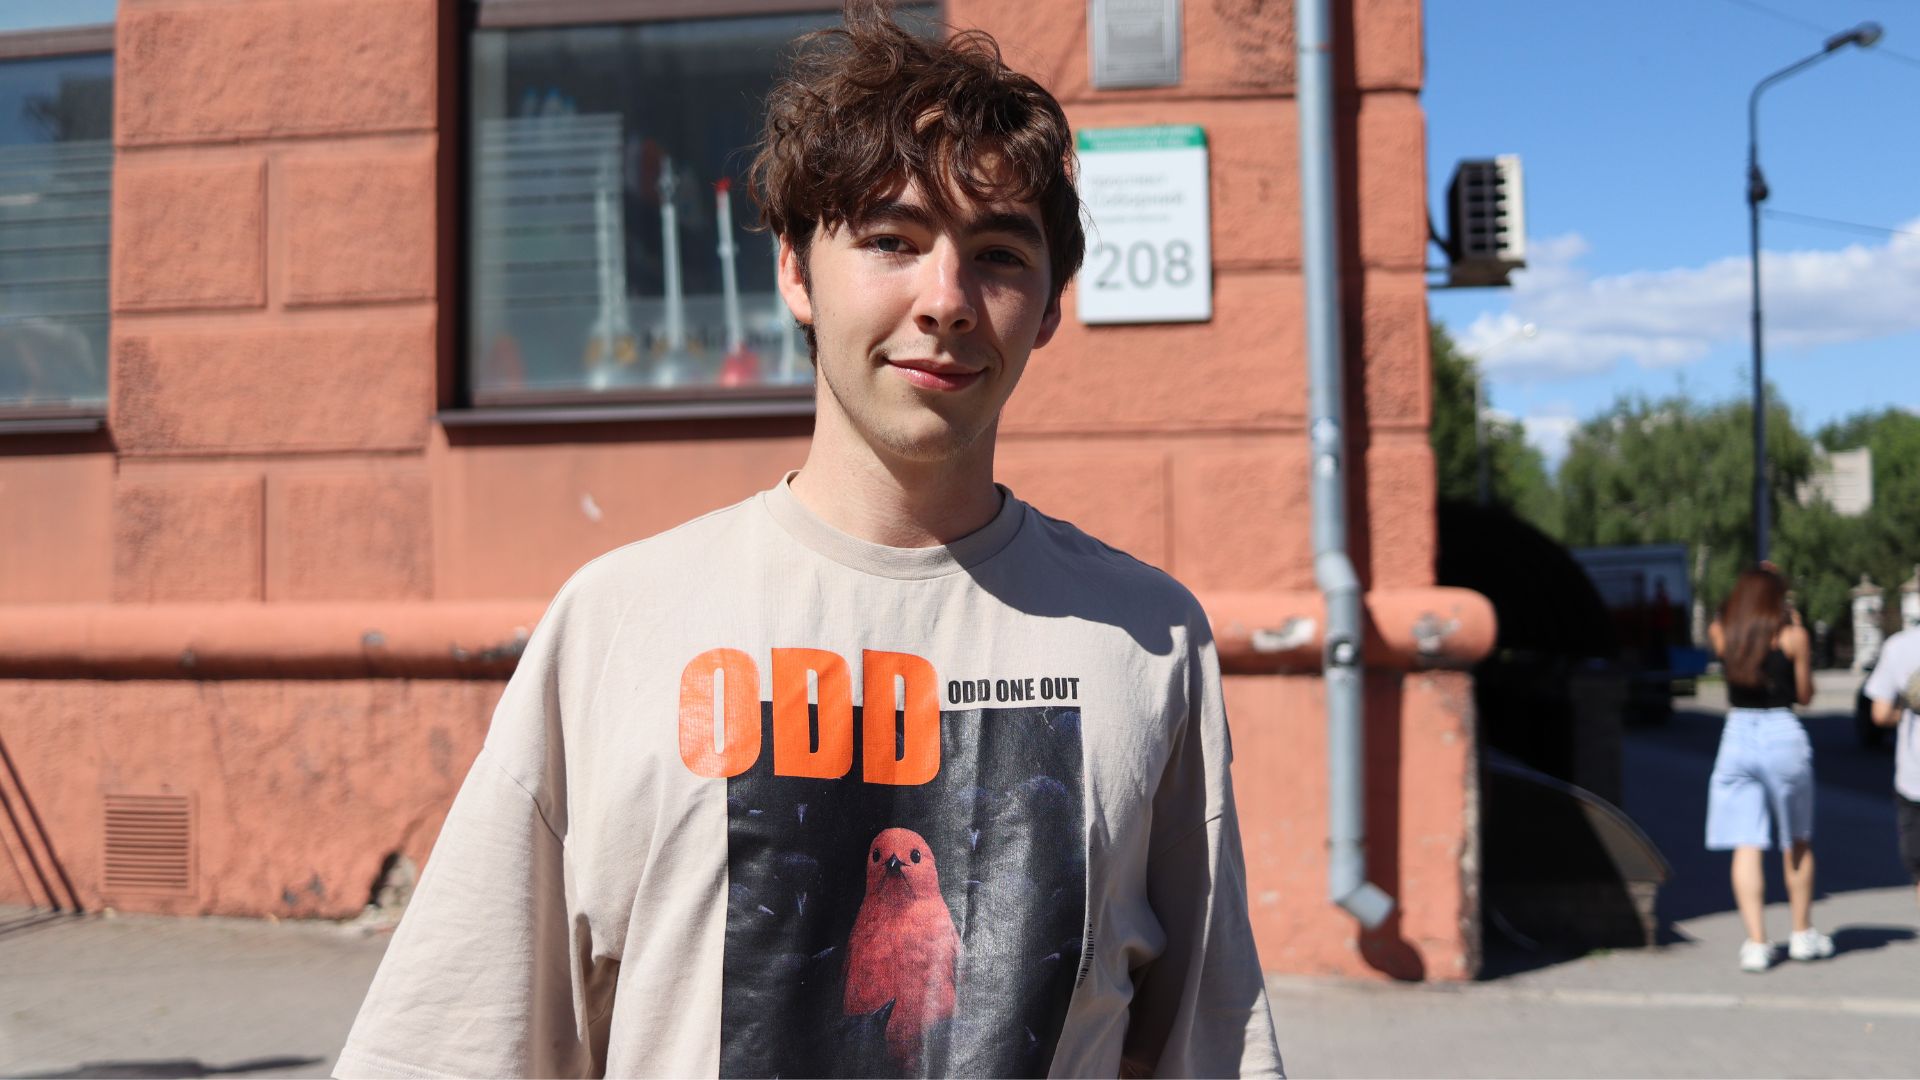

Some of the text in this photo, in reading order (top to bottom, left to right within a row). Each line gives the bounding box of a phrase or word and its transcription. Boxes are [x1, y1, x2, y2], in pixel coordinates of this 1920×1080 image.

[1091, 239, 1195, 291] 208
[678, 647, 941, 786] ODD
[948, 677, 1080, 704] ODD ONE OUT
